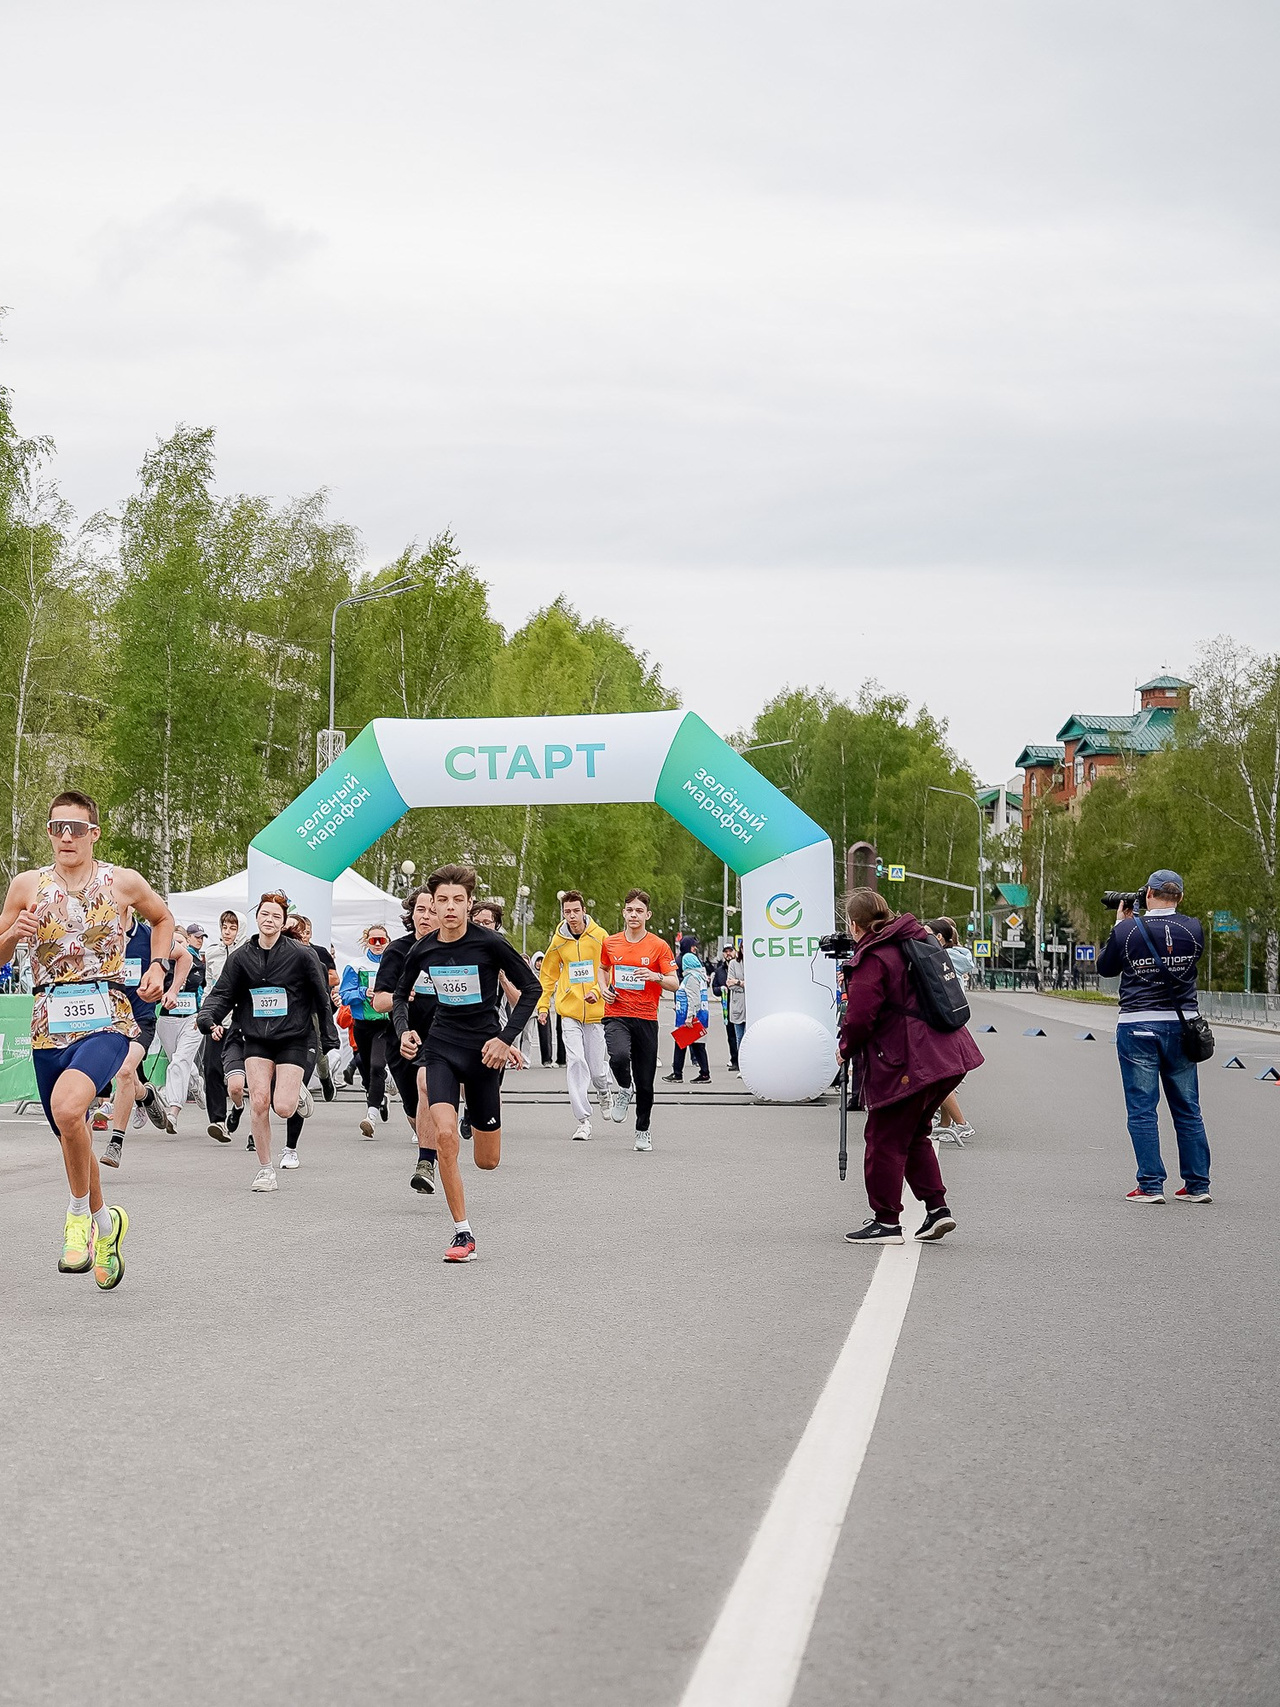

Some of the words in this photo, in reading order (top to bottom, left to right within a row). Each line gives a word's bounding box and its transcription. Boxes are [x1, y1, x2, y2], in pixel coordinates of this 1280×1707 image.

[444, 743, 606, 781] СТАРТ
[296, 772, 360, 838] зелёный
[694, 767, 768, 832] зелёный
[306, 787, 371, 850] марафон
[682, 779, 753, 844] марафон
[752, 936, 821, 958] СБЕР
[641, 957, 650, 965] 10
[1132, 955, 1193, 967] КОСОПОРТ
[442, 982, 468, 993] 3365
[63, 1003, 95, 1017] 3355
[260, 998, 278, 1007] 3377
